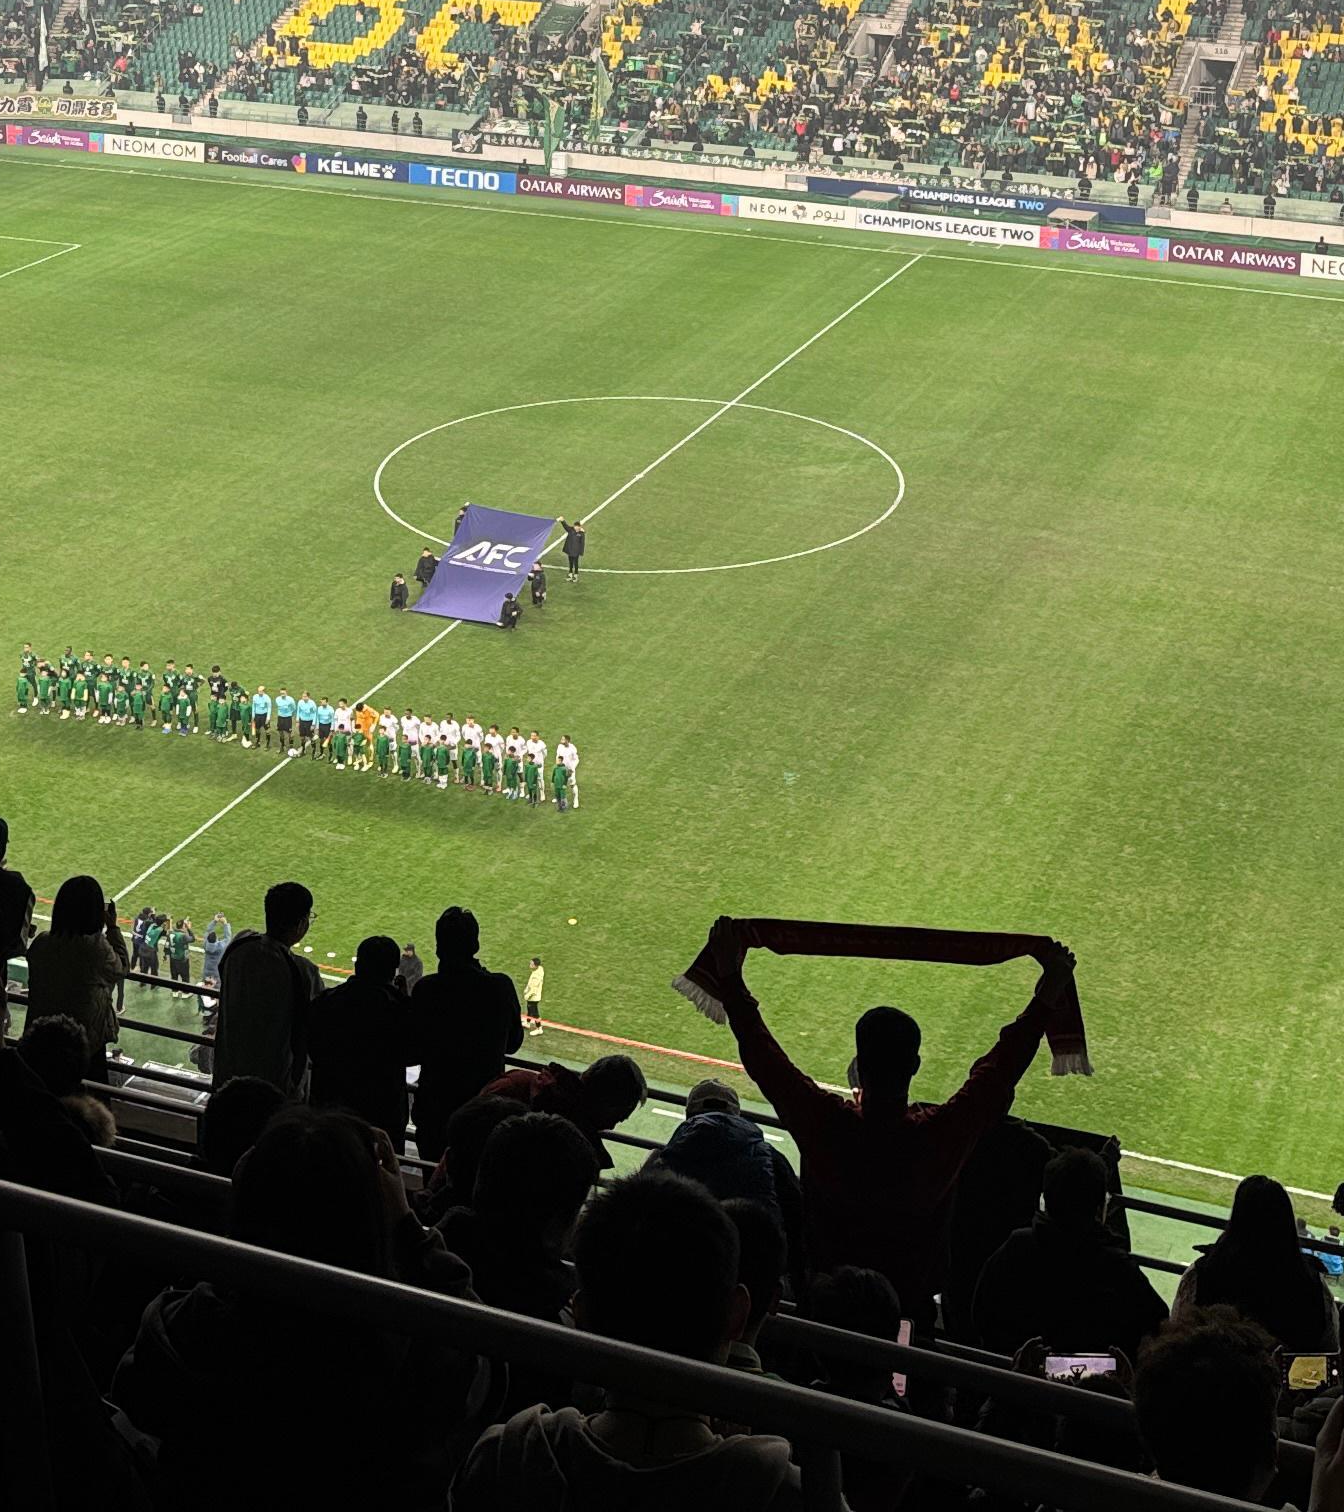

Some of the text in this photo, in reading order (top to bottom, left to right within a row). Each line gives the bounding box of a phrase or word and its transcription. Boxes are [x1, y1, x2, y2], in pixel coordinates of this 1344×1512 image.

[112, 138, 197, 159] NEOM.COM
[221, 149, 288, 168] Football Cares
[317, 158, 381, 178] KELME
[426, 166, 500, 191] TECNO
[519, 178, 622, 200] QATAR AIRWAYS
[749, 202, 787, 215] NEOM
[914, 191, 1045, 211] CHAMPIONS LEAGUE TWO
[863, 214, 942, 232] CHAMPIONS
[946, 222, 997, 238] LEAGUE
[1001, 227, 1034, 241] TWO
[1066, 232, 1110, 251] Saudi
[1172, 244, 1297, 270] QATAR AIRWAYS
[451, 541, 532, 569] AFC
